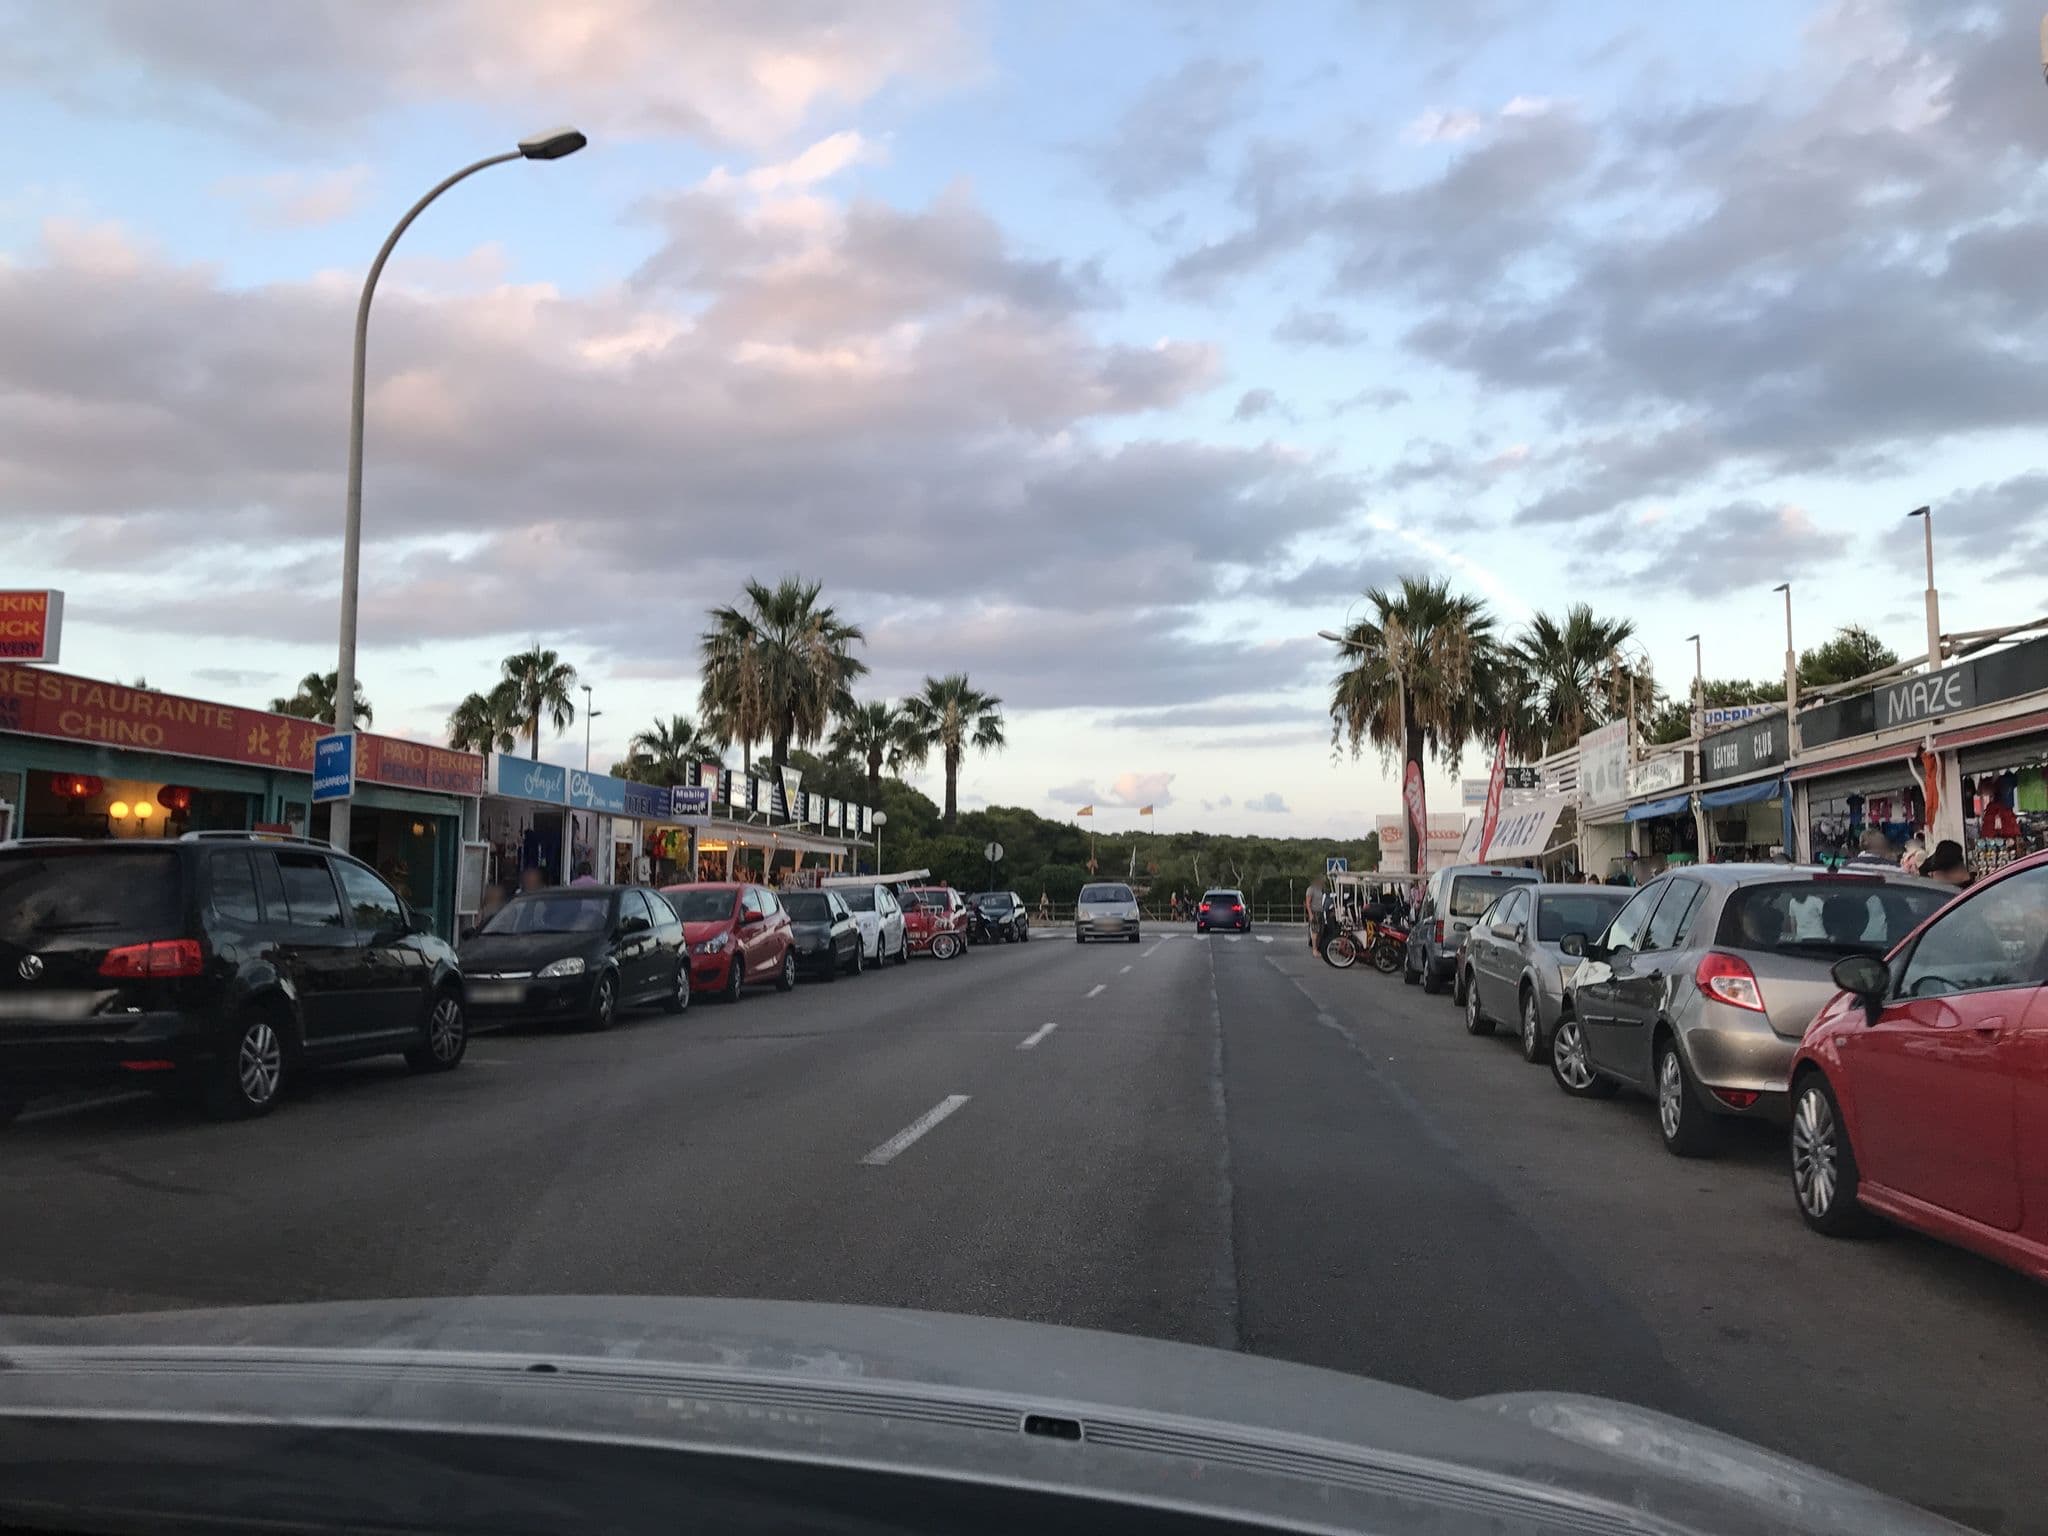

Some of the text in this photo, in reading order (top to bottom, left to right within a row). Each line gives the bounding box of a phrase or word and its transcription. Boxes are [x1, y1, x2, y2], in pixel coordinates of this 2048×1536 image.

[1888, 671, 1962, 724] MAZE
[58, 710, 164, 746] CHINO
[383, 742, 473, 771] PATO PEKIN
[1713, 731, 1773, 770] LEATHER CLUB
[524, 765, 562, 798] Angel
[571, 773, 594, 807] City
[675, 789, 705, 799] Mobile
